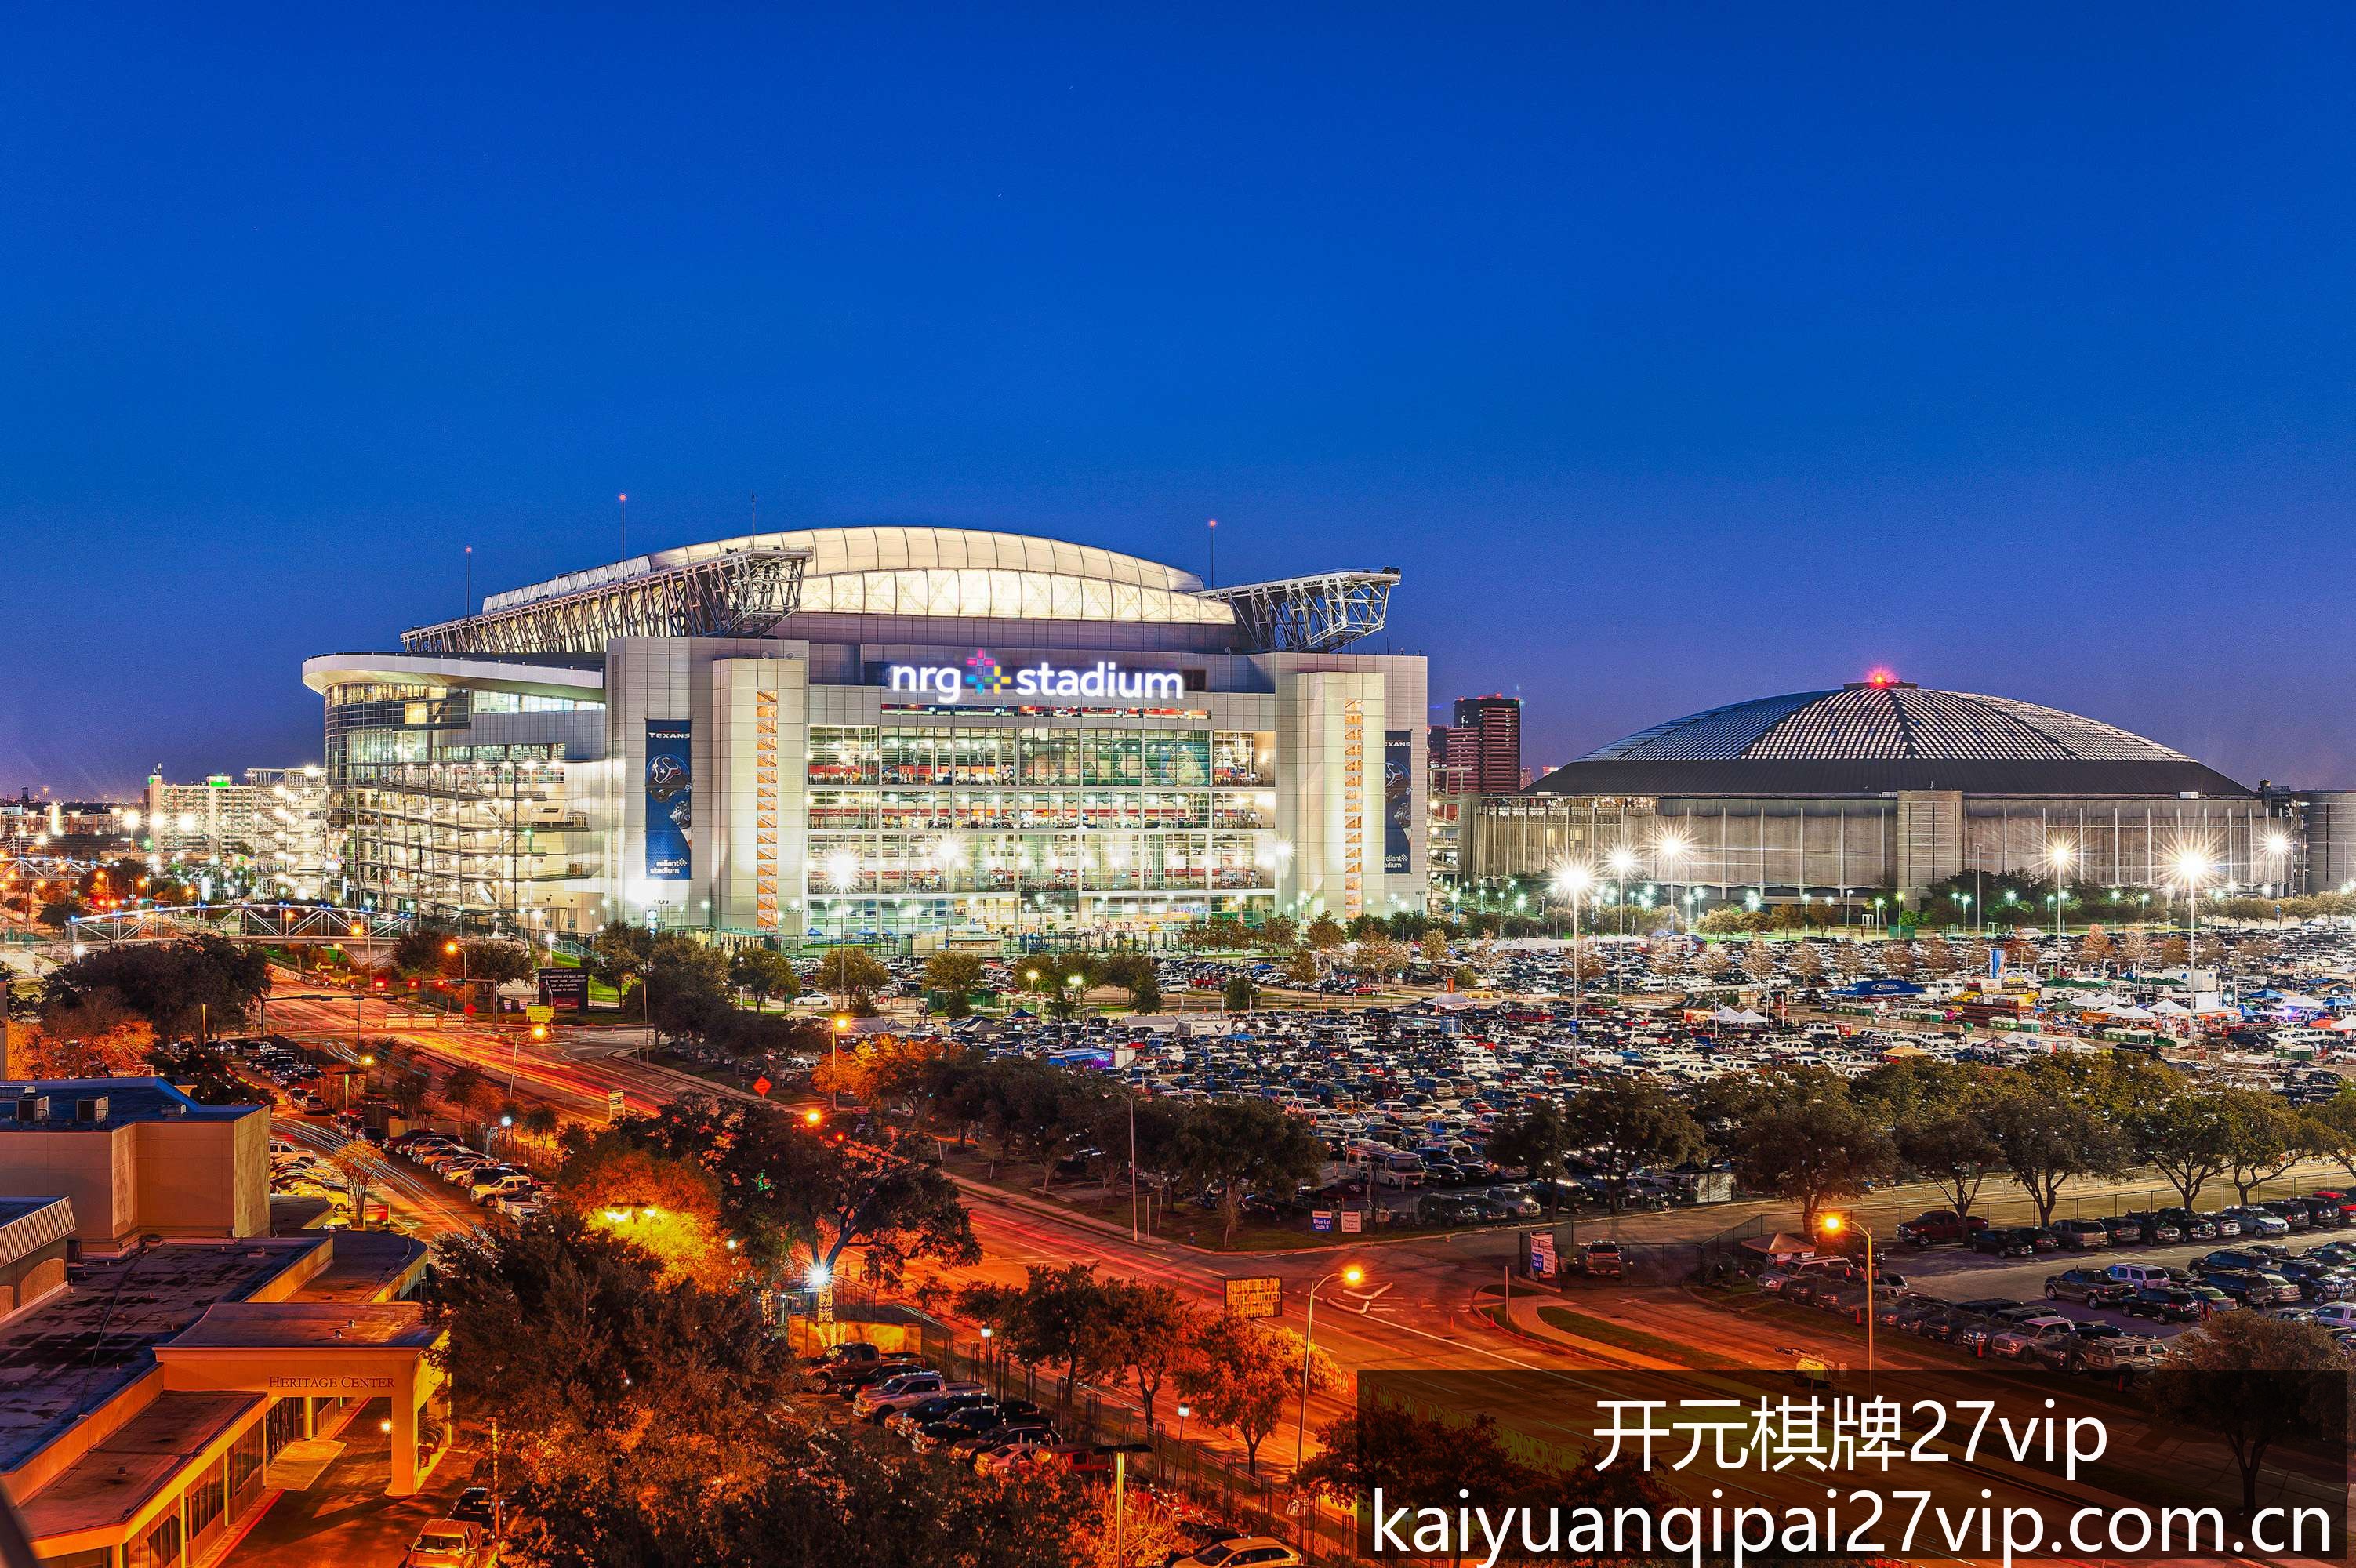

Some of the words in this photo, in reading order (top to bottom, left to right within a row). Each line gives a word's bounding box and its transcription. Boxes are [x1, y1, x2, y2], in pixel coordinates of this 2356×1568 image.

[891, 666, 961, 703] nrg
[1015, 662, 1184, 699] stadium
[269, 1376, 337, 1388] HERITAGE
[341, 1376, 395, 1388] CENTER
